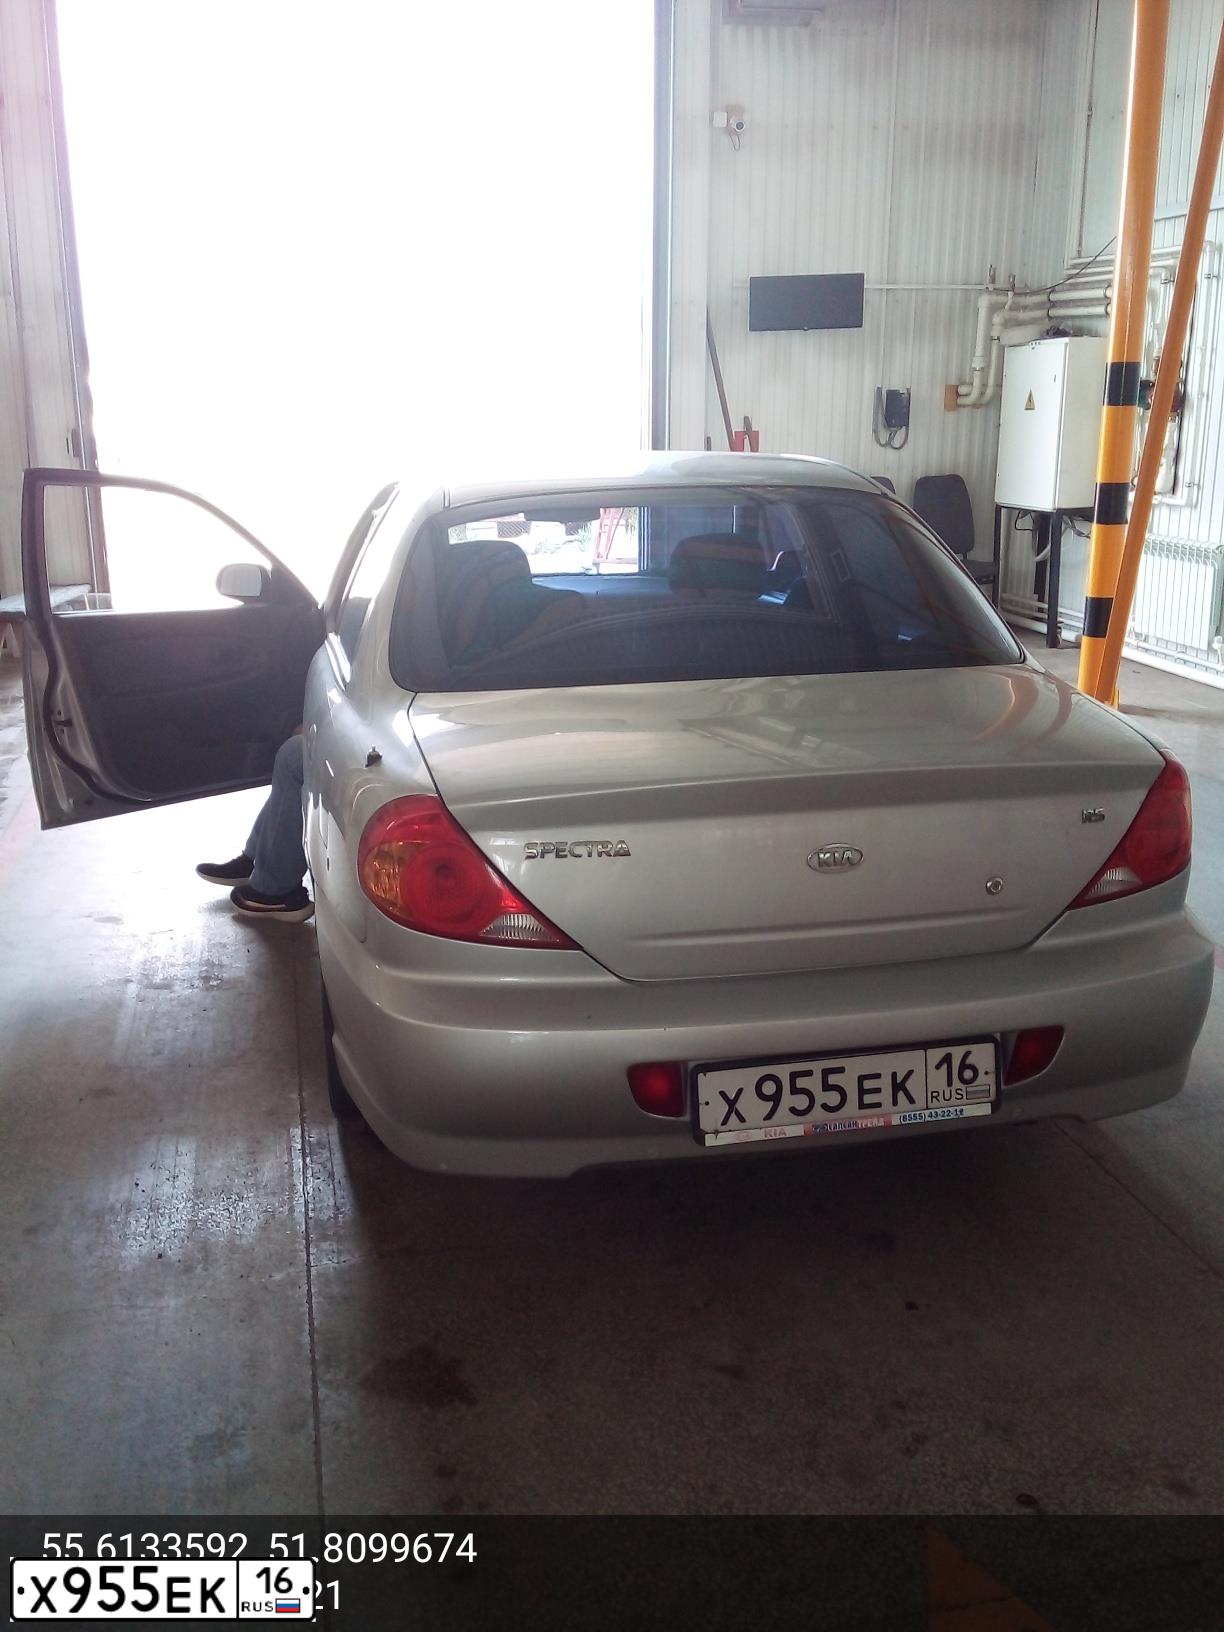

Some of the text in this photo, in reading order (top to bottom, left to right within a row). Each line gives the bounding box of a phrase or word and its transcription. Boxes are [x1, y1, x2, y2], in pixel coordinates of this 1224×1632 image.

[524, 839, 631, 860] SPECTRA
[817, 847, 857, 868] KIA
[934, 1050, 979, 1087] 16
[930, 1087, 965, 1103] RUS
[763, 1126, 787, 1139] KIA
